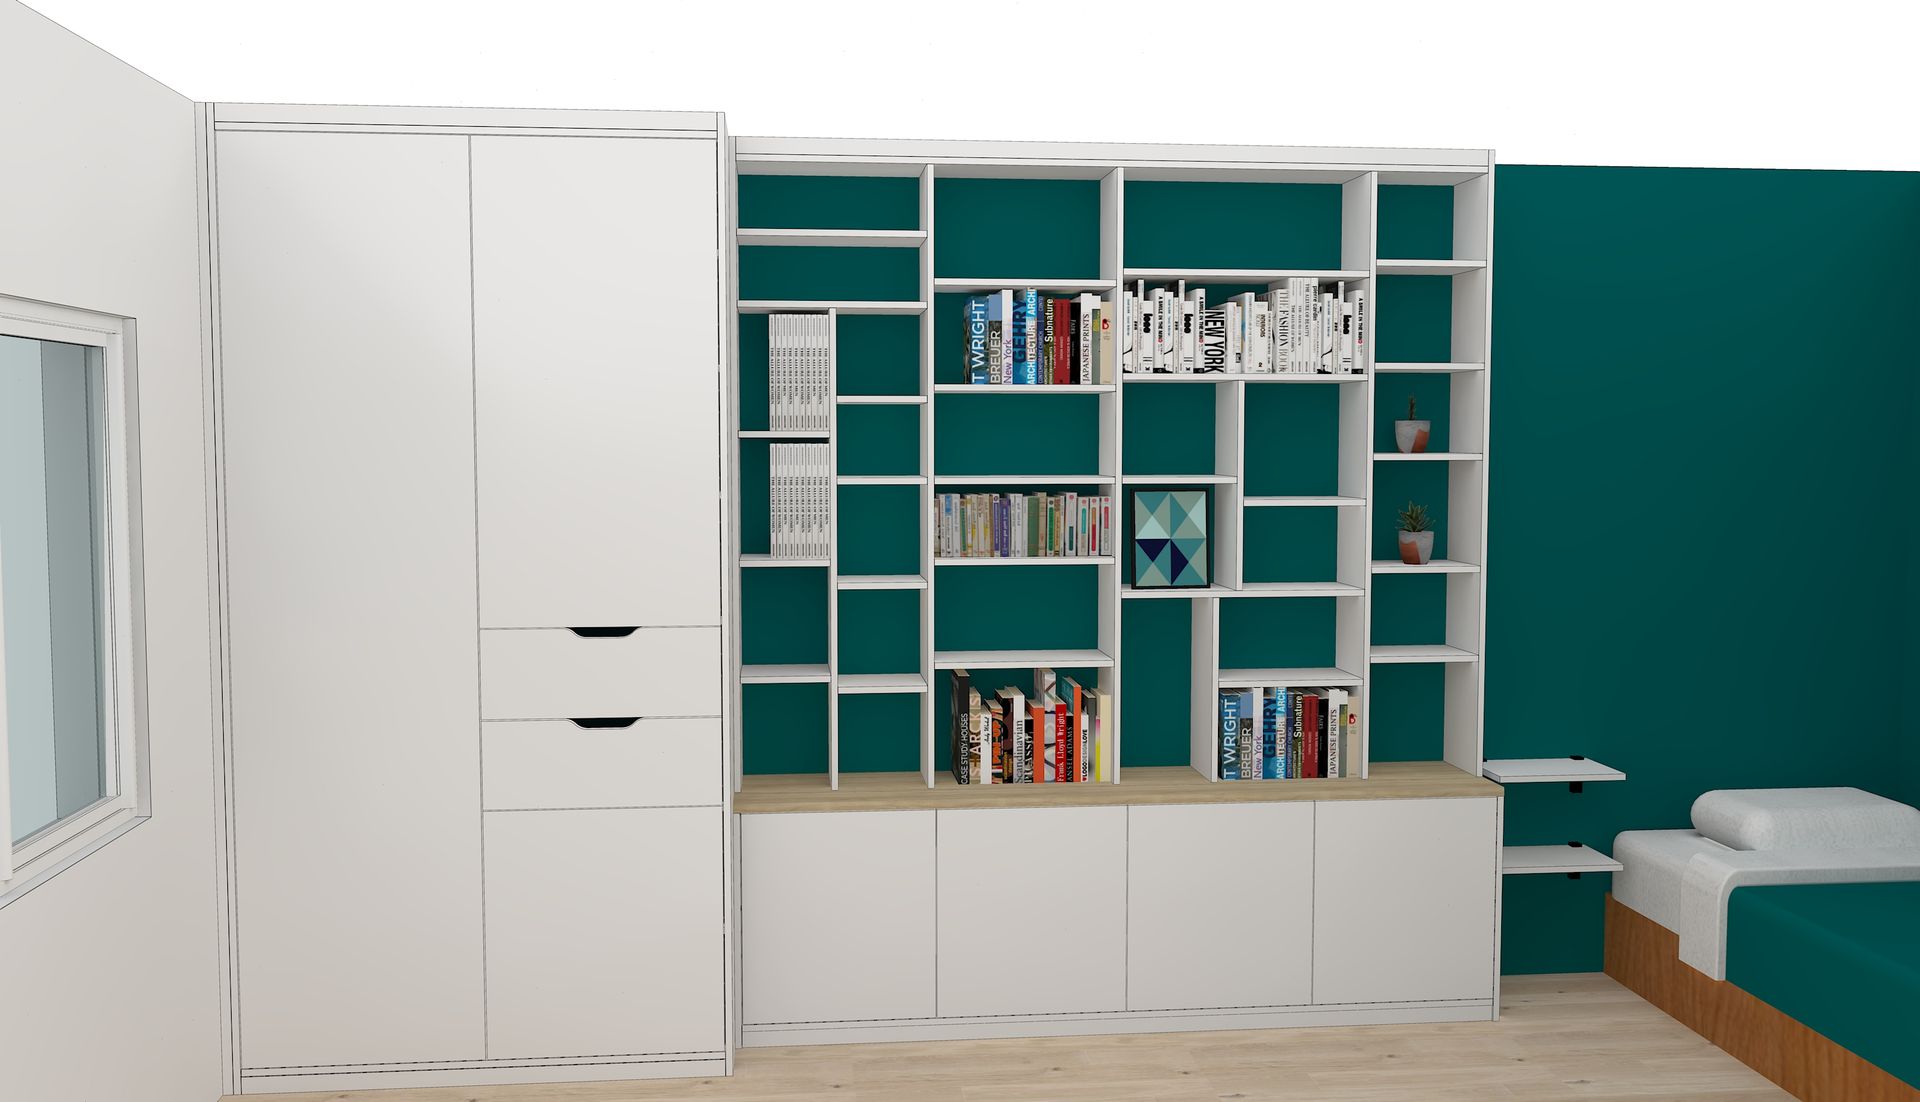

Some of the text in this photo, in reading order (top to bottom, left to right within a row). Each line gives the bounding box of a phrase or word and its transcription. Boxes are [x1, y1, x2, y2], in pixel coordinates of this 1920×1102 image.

[972, 300, 985, 368] WRIGHT
[1013, 300, 1026, 363] GEHRY
[1045, 299, 1053, 342] Subnature
[1204, 311, 1224, 373] NEW YORK
[1279, 291, 1288, 372] THE FASHION BOOK
[990, 330, 1000, 383] BREUER
[1003, 339, 1012, 384] New York
[1027, 319, 1035, 384] ARCHITECTURE
[1224, 699, 1236, 764] WRIGHT
[1254, 736, 1262, 755] York
[1263, 698, 1276, 758] GEHRY
[1294, 696, 1302, 737] Subnature
[1014, 720, 1023, 783] Scandinavian
[1025, 734, 1033, 783] PICASSO
[1242, 728, 1251, 778] BREUER
